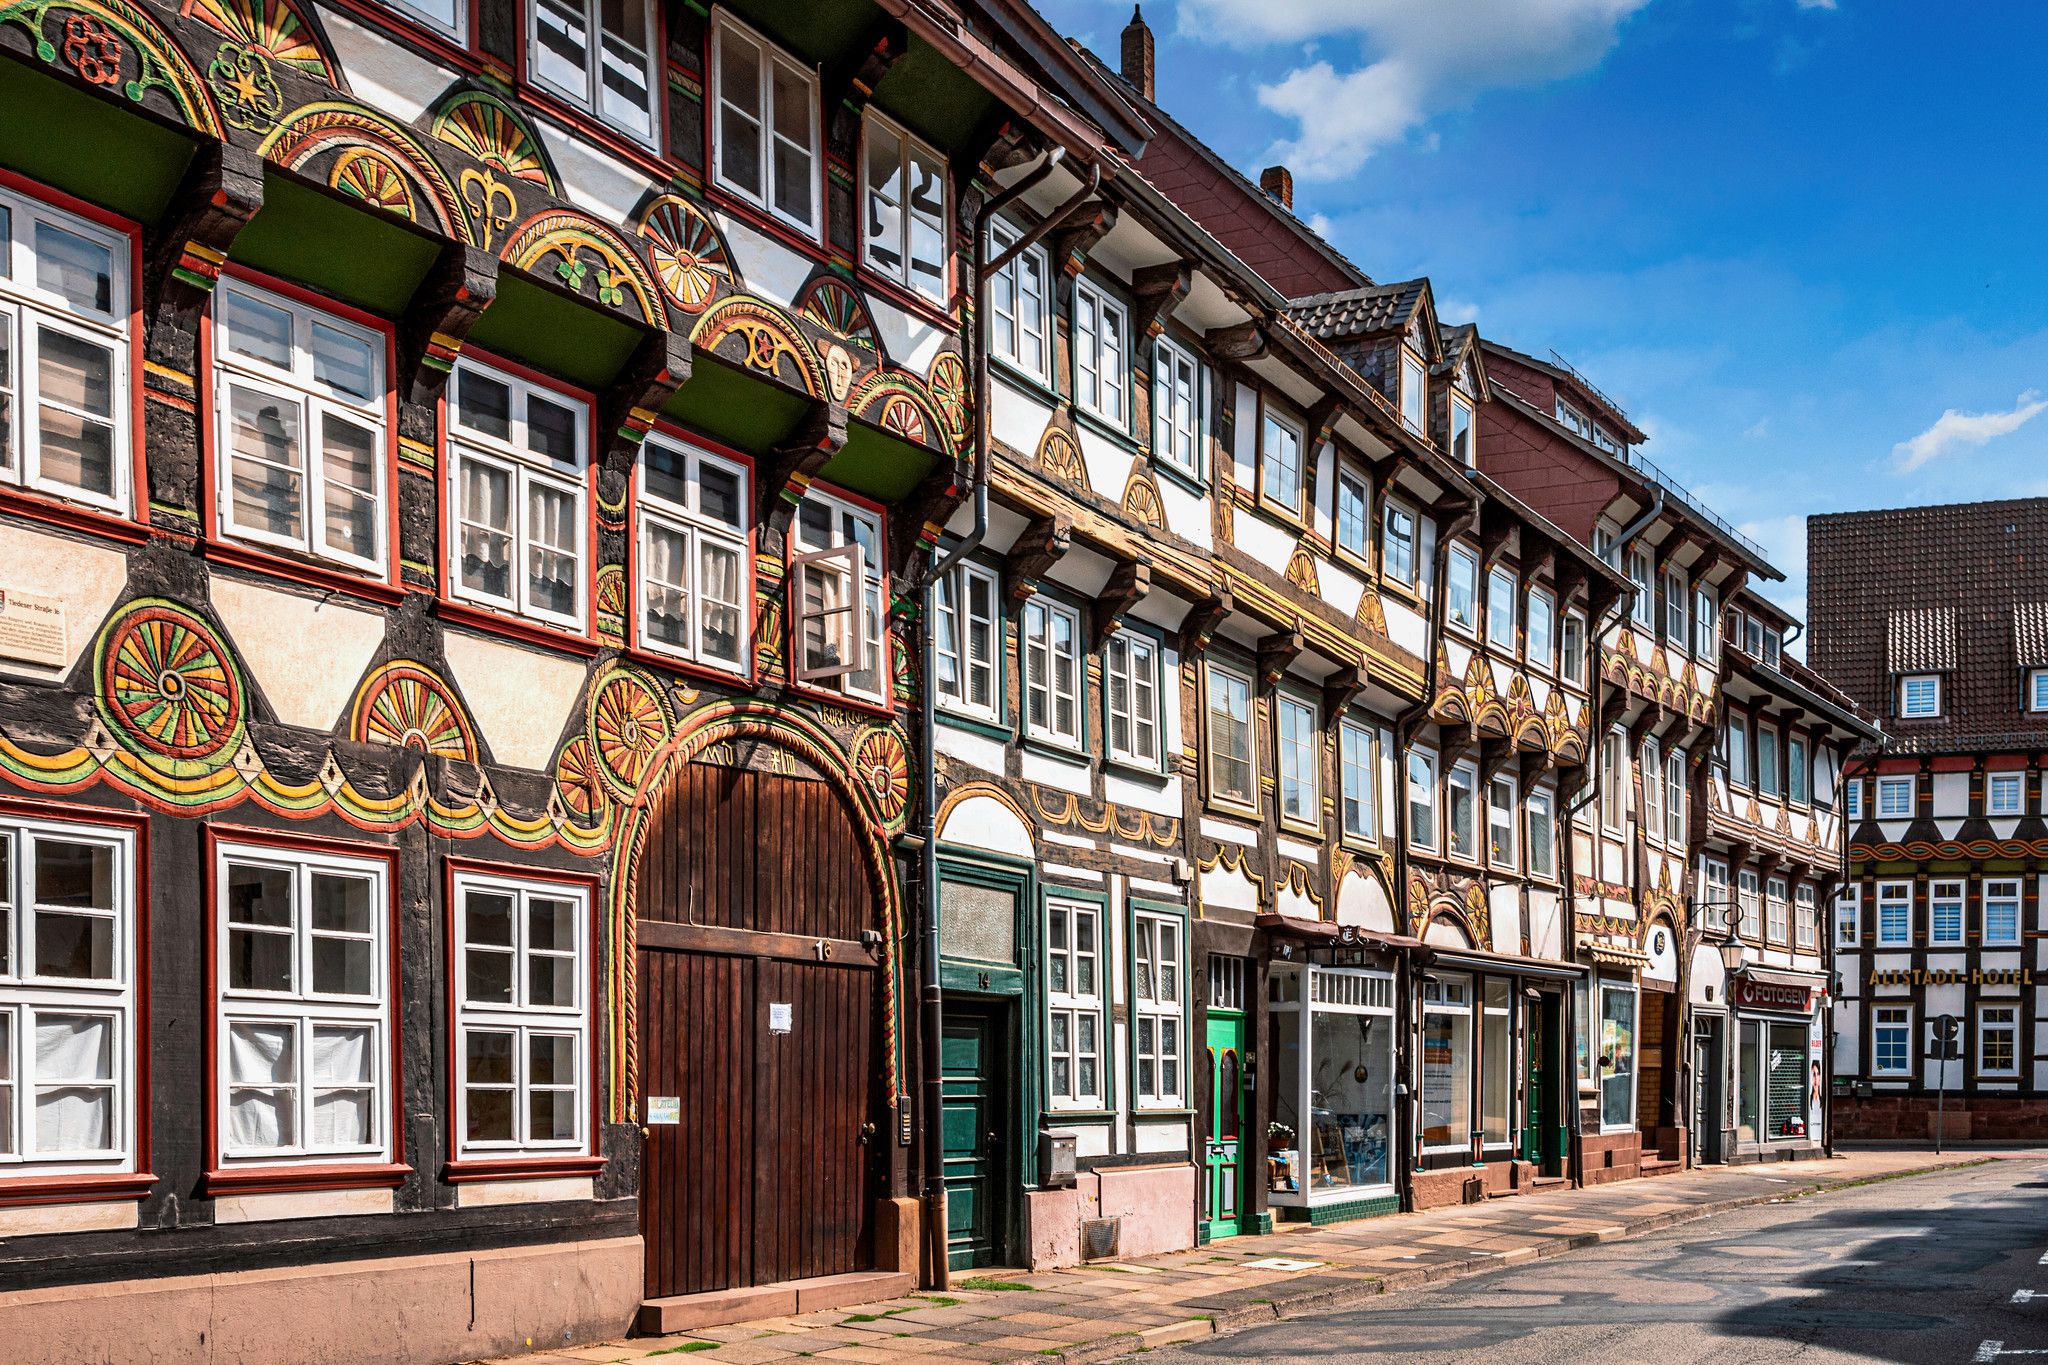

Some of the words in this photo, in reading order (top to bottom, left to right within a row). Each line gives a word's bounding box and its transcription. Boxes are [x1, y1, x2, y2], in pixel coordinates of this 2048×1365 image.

[34, 603, 53, 614] Straße
[815, 940, 831, 960] 16
[977, 972, 990, 989] 14
[1869, 968, 2033, 986] ALTSTADT-HOTEL
[1755, 985, 1806, 1005] FOTOGEN
